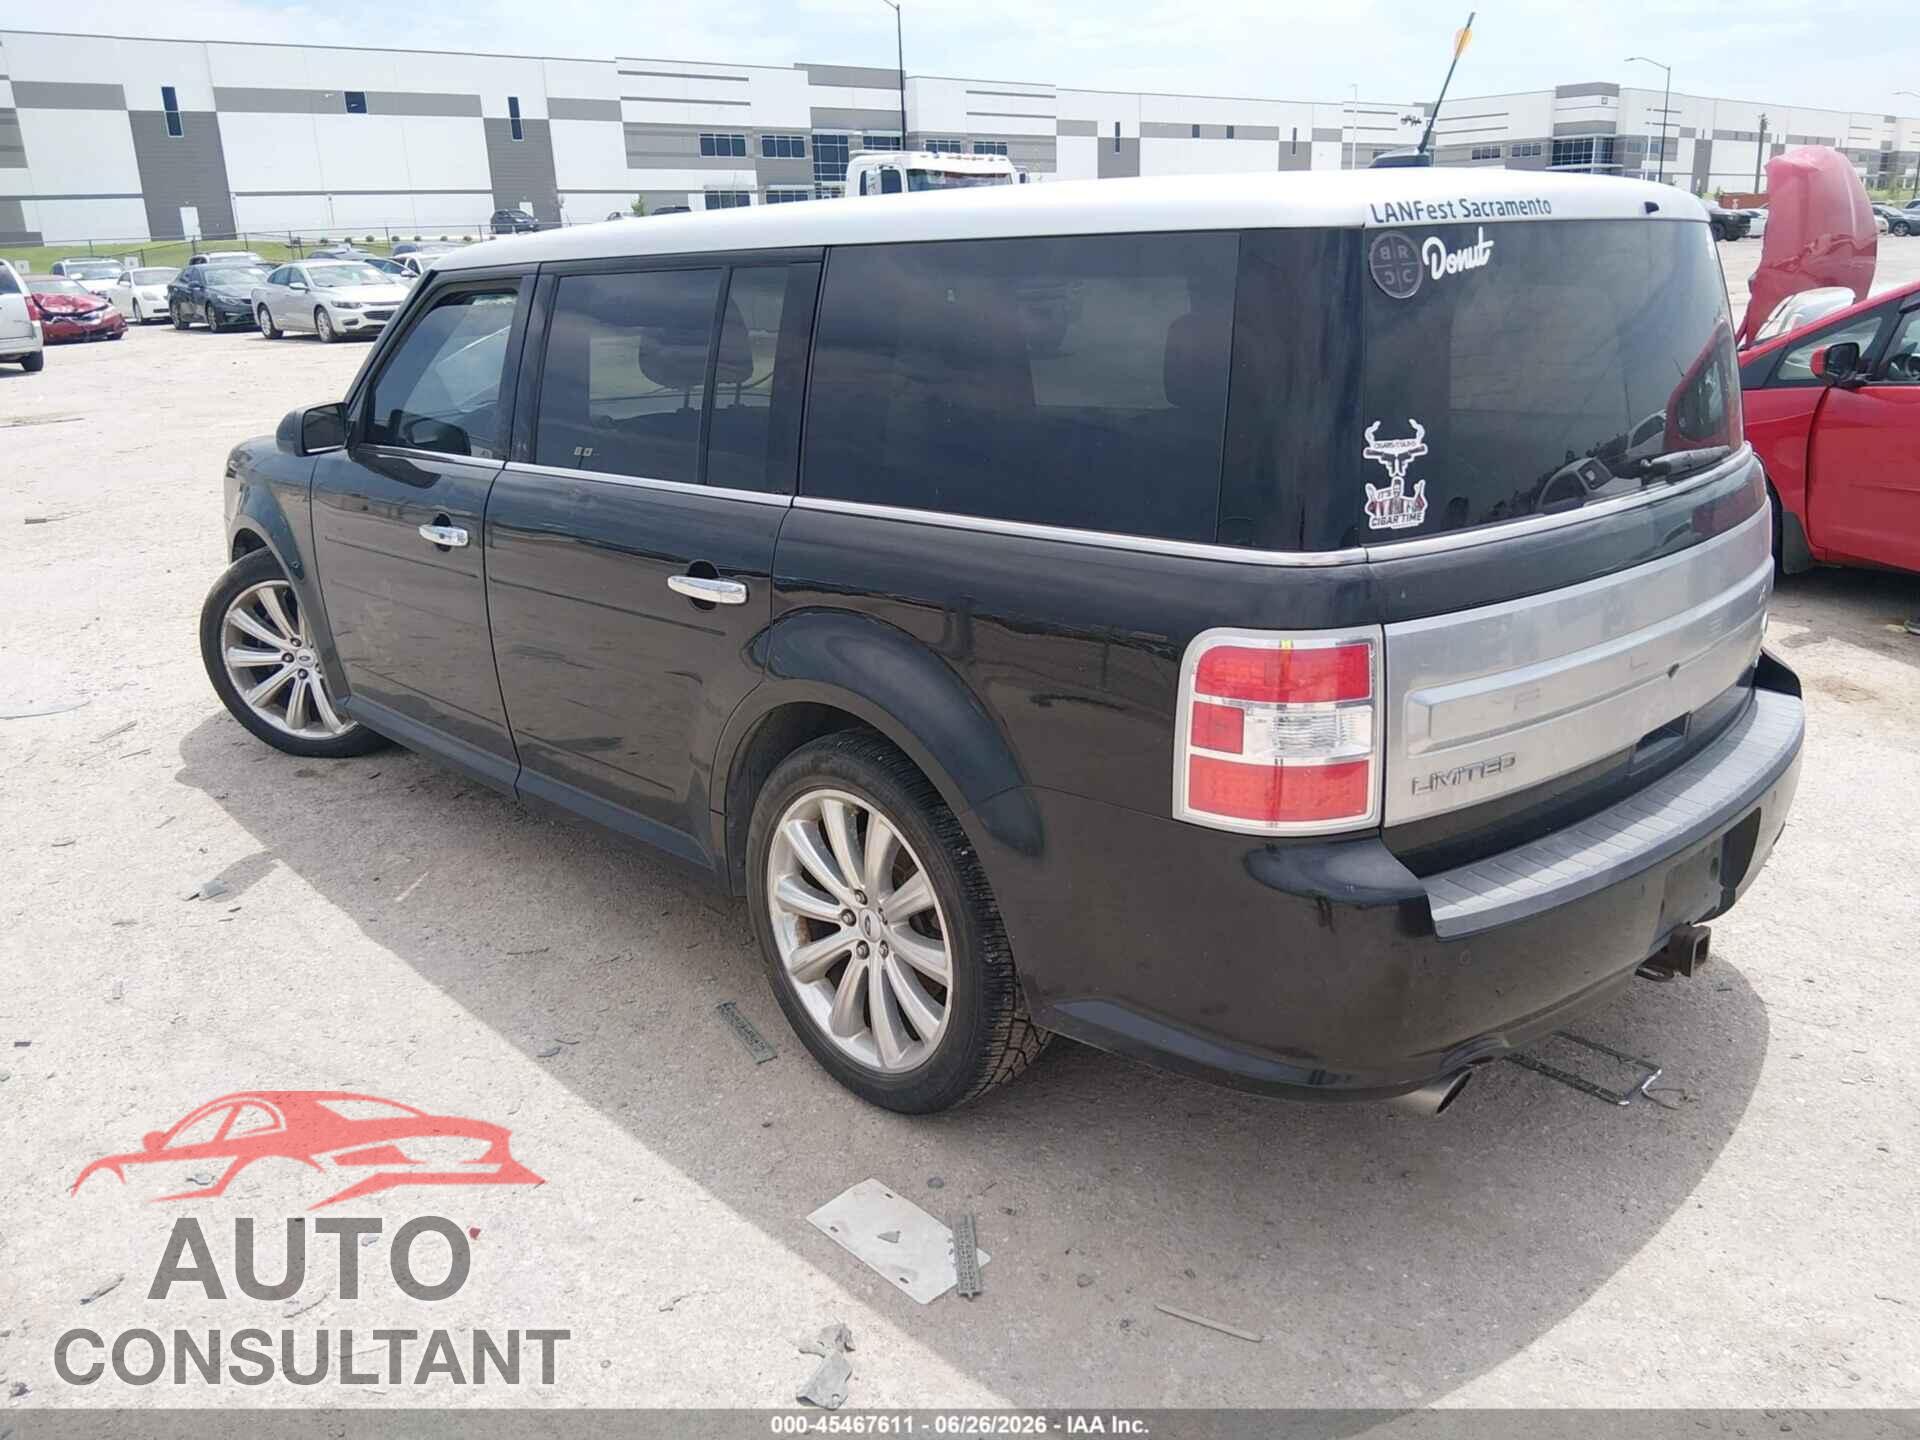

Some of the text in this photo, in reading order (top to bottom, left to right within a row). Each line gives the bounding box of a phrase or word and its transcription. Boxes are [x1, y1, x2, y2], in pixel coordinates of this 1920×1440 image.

[1370, 197, 1552, 224] LANFest Sacramento
[1422, 226, 1494, 280] Donut
[1400, 511, 1423, 523] TIME
[1411, 752, 1516, 796] LIMITED
